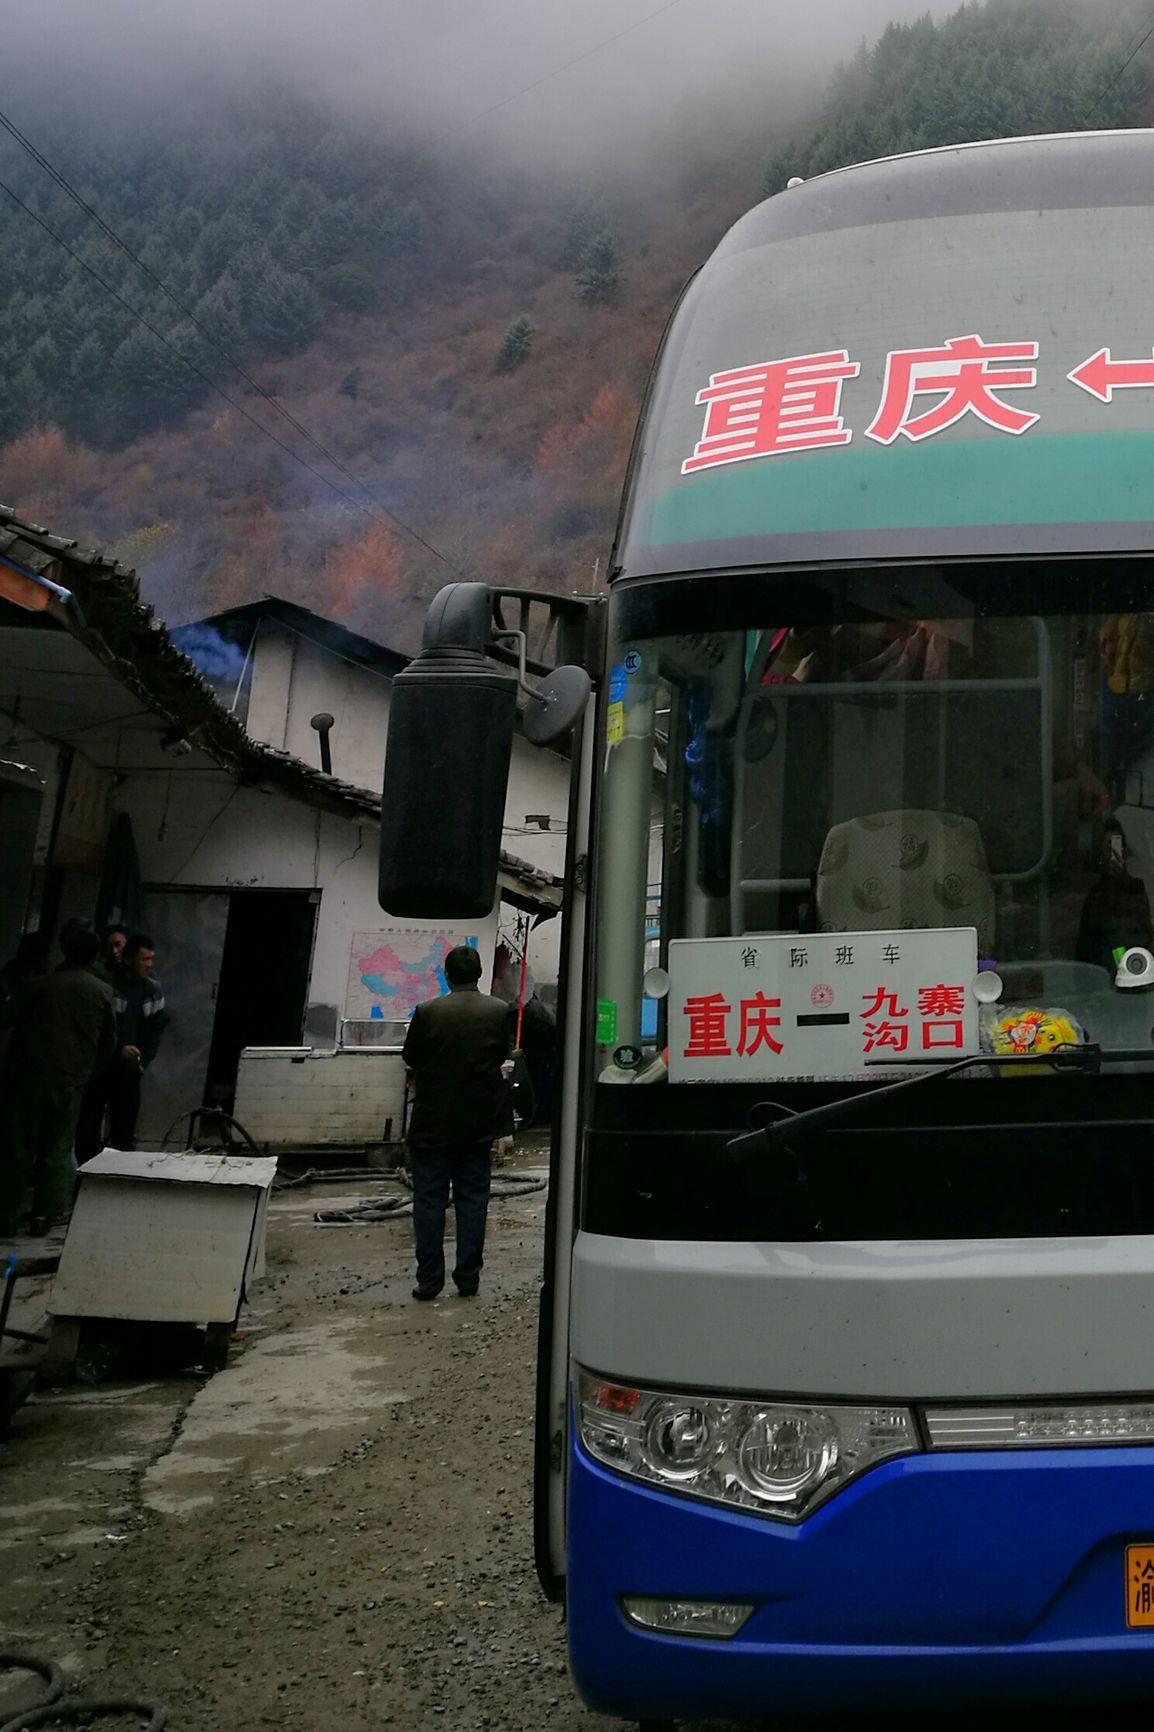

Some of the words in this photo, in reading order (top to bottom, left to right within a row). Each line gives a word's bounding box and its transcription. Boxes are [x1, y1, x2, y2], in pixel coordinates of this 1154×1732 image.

[681, 334, 1040, 474] 重庆
[740, 943, 901, 969] 省际班车
[859, 983, 965, 1019] 九寨
[683, 991, 784, 1058] 重庆
[862, 1020, 963, 1053] 沟口
